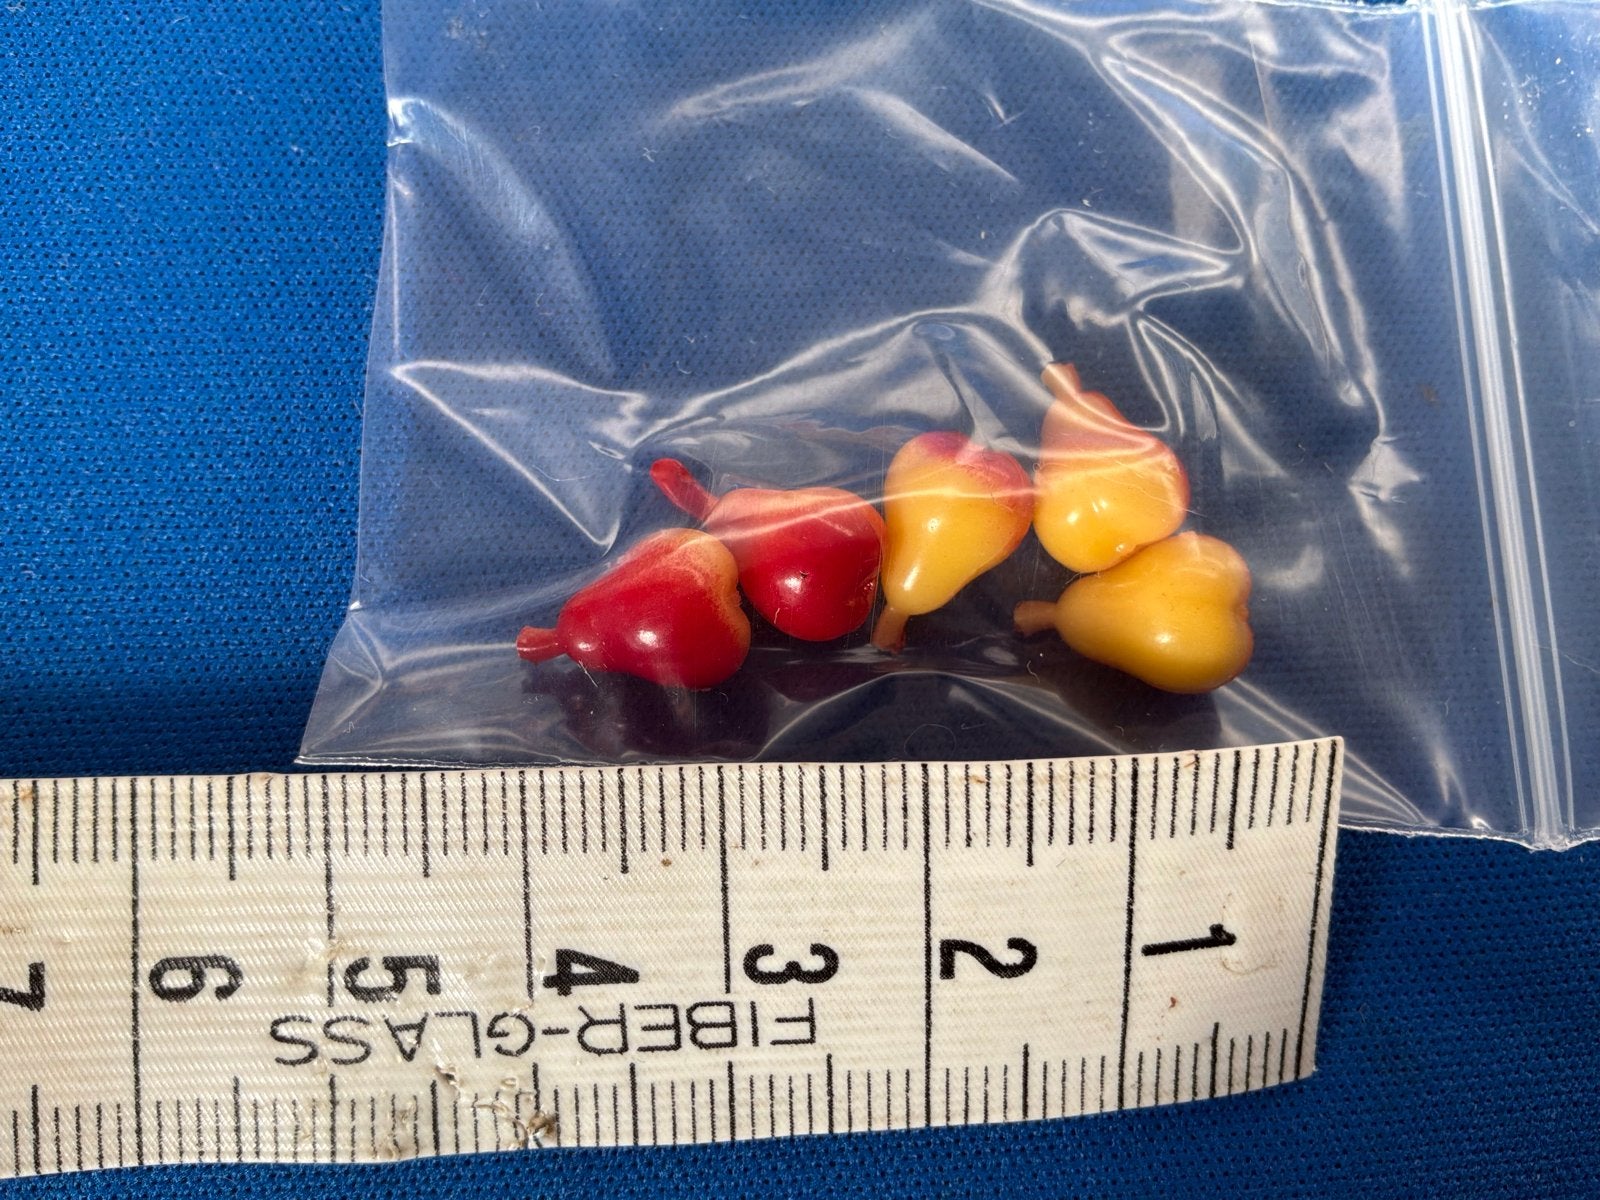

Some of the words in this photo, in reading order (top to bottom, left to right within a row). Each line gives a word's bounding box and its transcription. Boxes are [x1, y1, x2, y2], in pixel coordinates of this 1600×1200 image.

[939, 937, 1038, 981] 2
[1142, 924, 1237, 956] 1
[149, 954, 243, 1001] 6
[344, 954, 441, 1001] 5
[543, 948, 640, 997] 4
[743, 943, 840, 985] 3
[270, 997, 817, 1066] FIBER-GLASS
